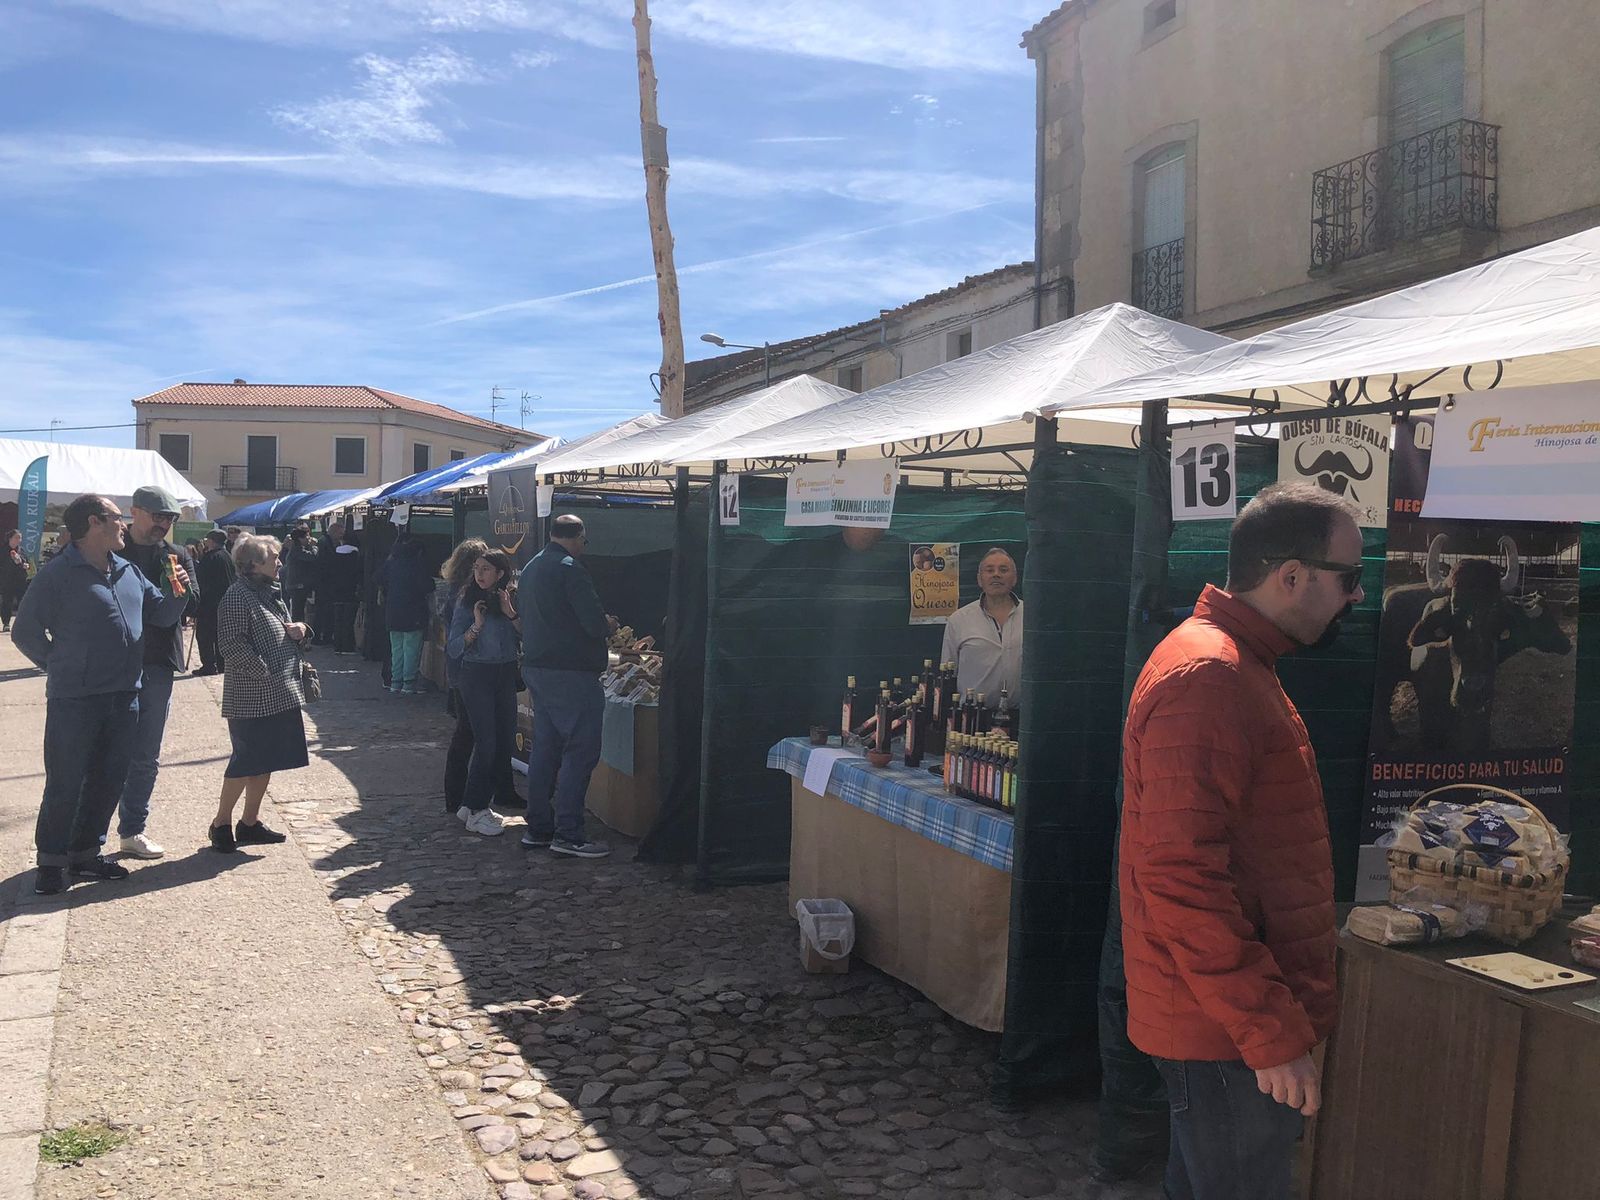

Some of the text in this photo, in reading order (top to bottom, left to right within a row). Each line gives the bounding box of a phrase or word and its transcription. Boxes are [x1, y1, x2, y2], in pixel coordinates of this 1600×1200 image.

[1282, 418, 1321, 442] QUESO
[1326, 416, 1341, 434] DE
[1345, 419, 1389, 453] BÚFALA
[1310, 434, 1365, 452] SIN LACTOSA
[1468, 416, 1520, 452] Feria
[1534, 434, 1597, 450] Hinojosa de
[1175, 443, 1231, 508] 13
[25, 471, 40, 553] CAJA RURAL
[721, 484, 738, 519] 12
[913, 588, 956, 609] Queso
[1372, 757, 1564, 780] BENEFICIOS PARA TU SALUD
